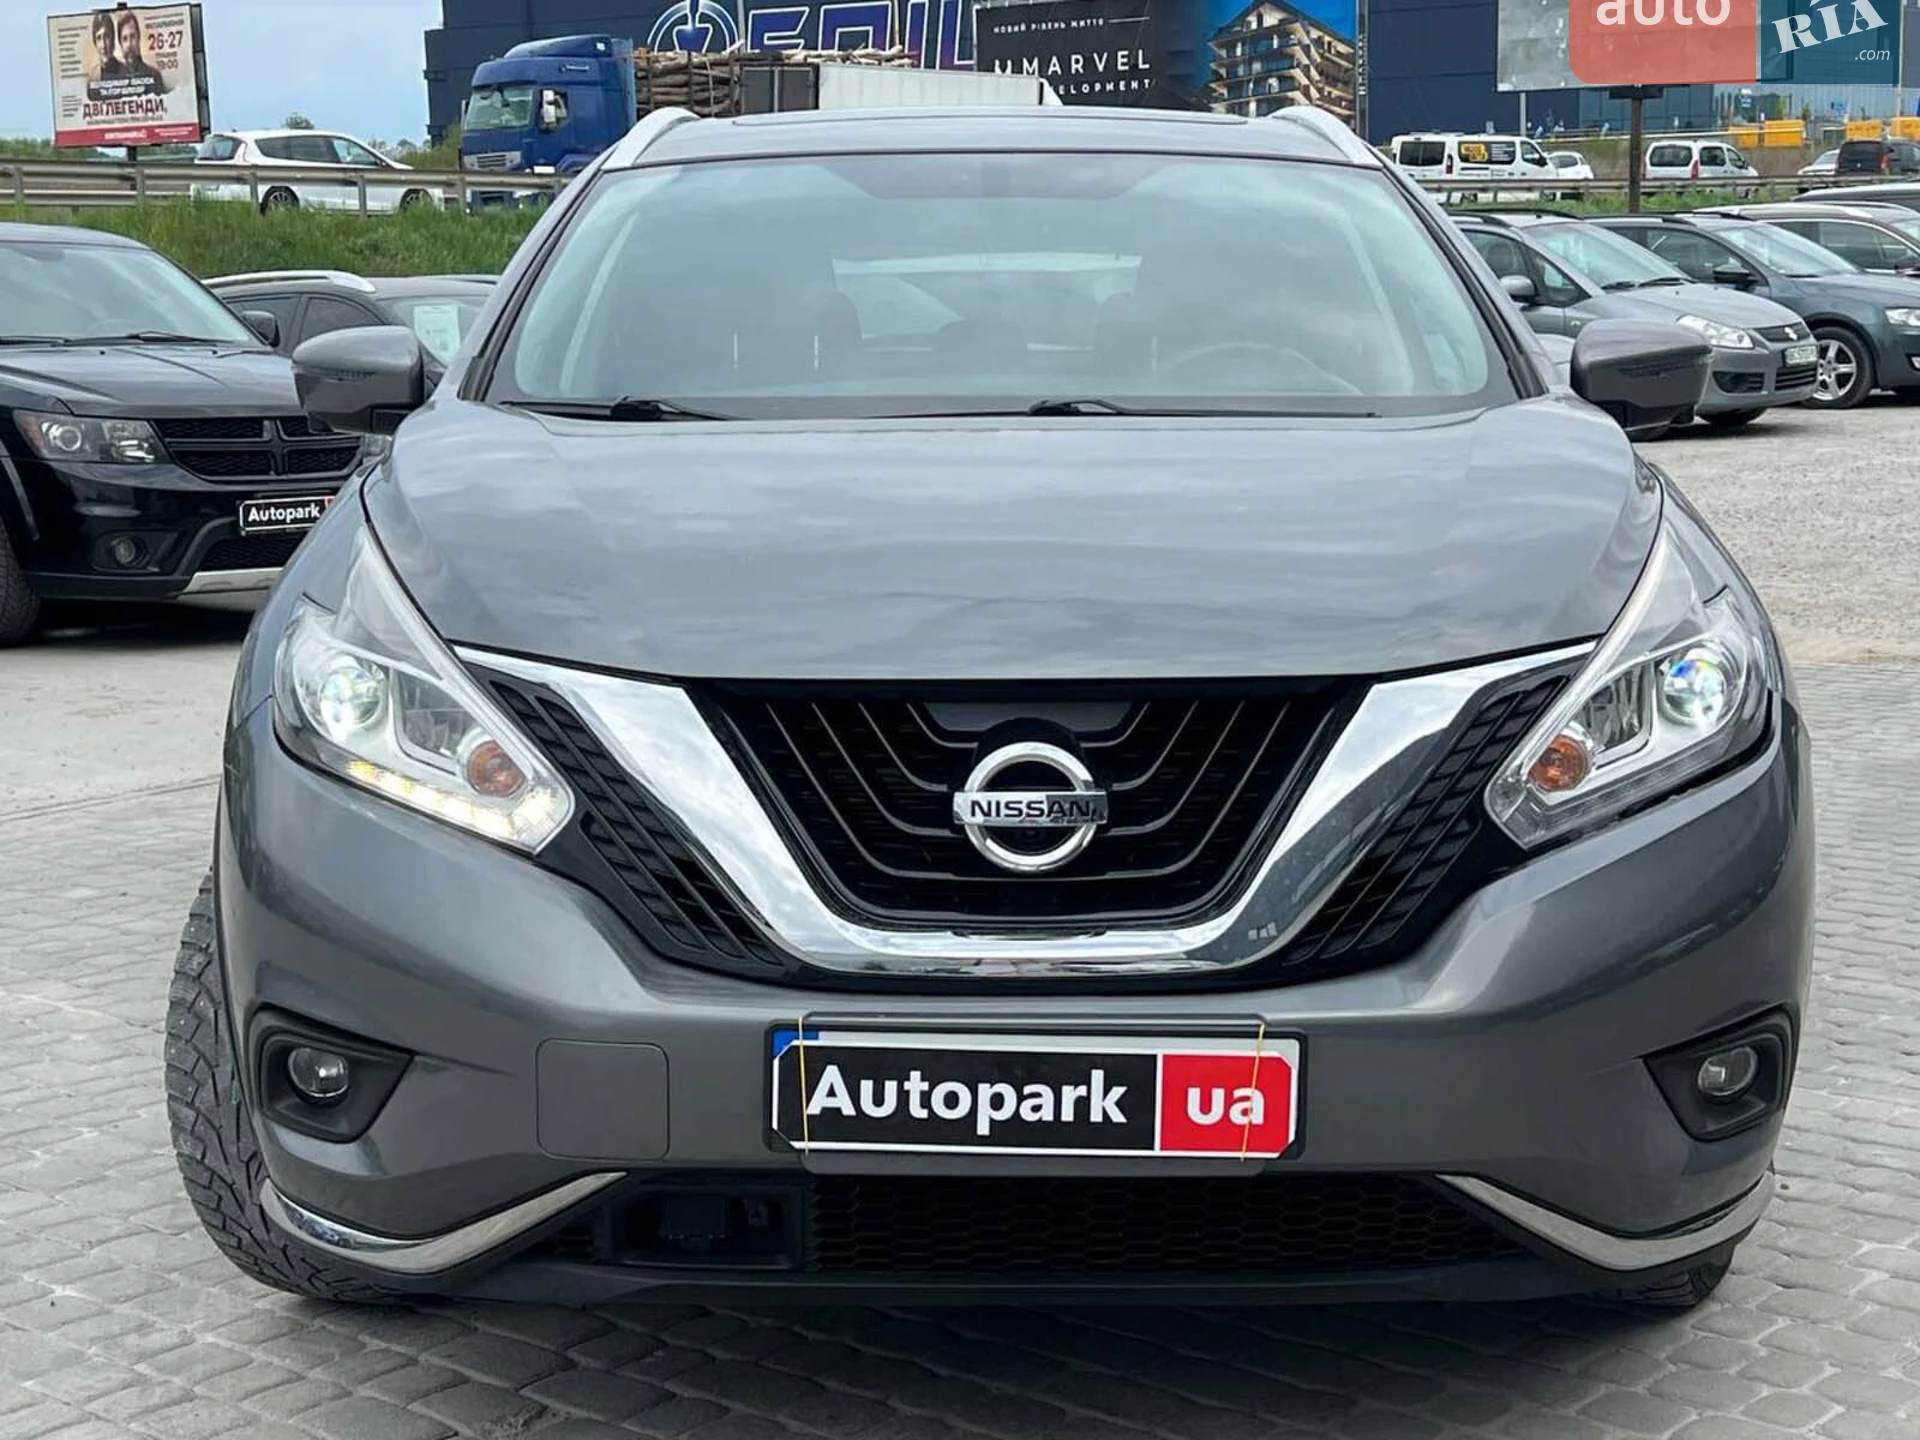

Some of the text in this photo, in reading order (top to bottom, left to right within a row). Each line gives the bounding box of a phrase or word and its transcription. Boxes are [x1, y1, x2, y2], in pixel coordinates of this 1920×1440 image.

[1057, 78, 1150, 95] ELOPMENT
[247, 502, 321, 524] Autopark
[970, 799, 1090, 819] NISSAN
[806, 1063, 1266, 1137] Autopark ua
